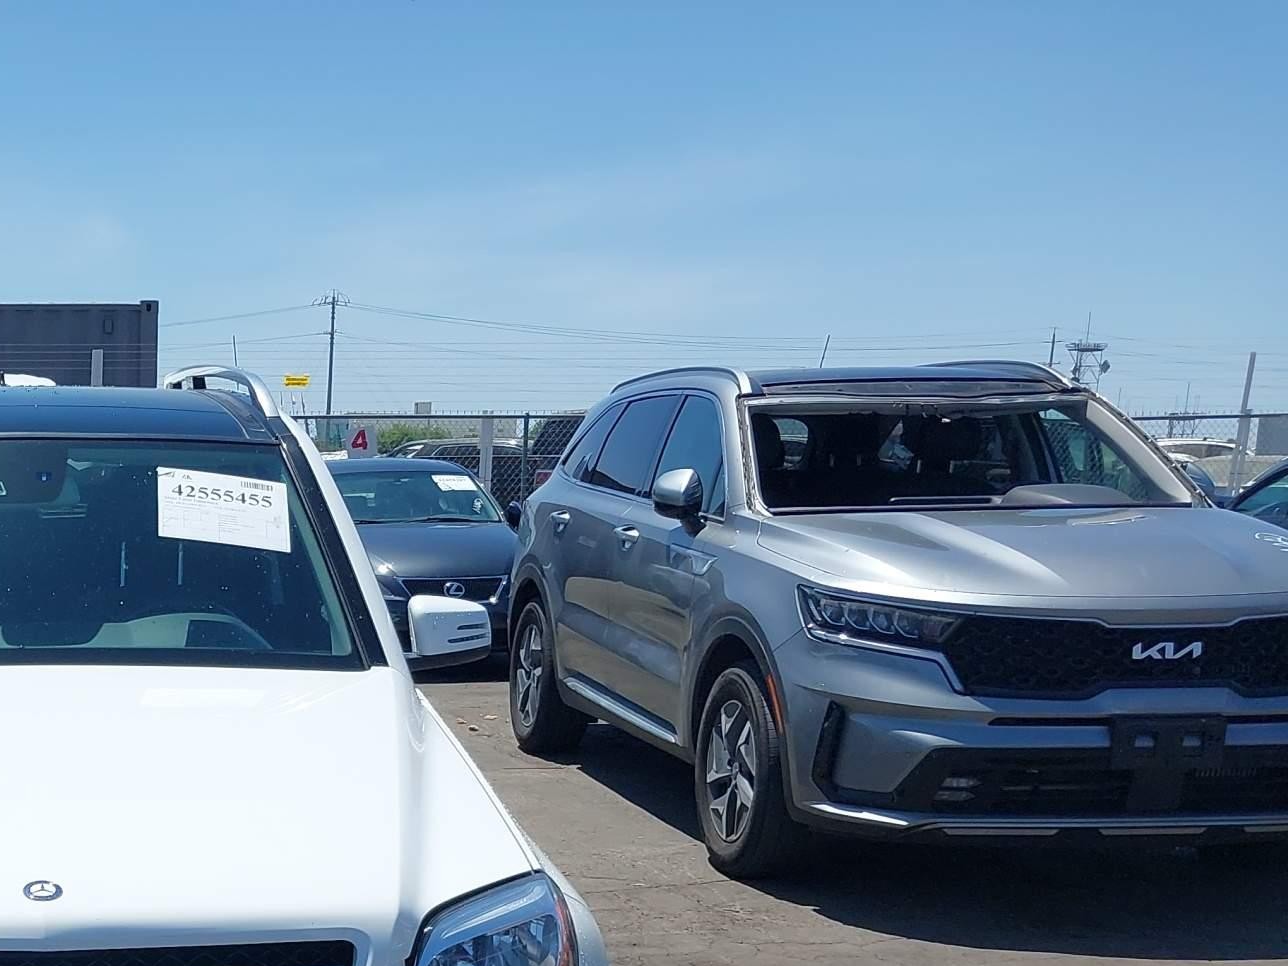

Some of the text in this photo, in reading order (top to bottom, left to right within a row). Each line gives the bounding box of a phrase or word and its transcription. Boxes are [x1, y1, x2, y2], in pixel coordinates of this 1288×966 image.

[351, 429, 368, 450] 4
[171, 483, 273, 509] 42555455
[1131, 641, 1203, 660] KIA
